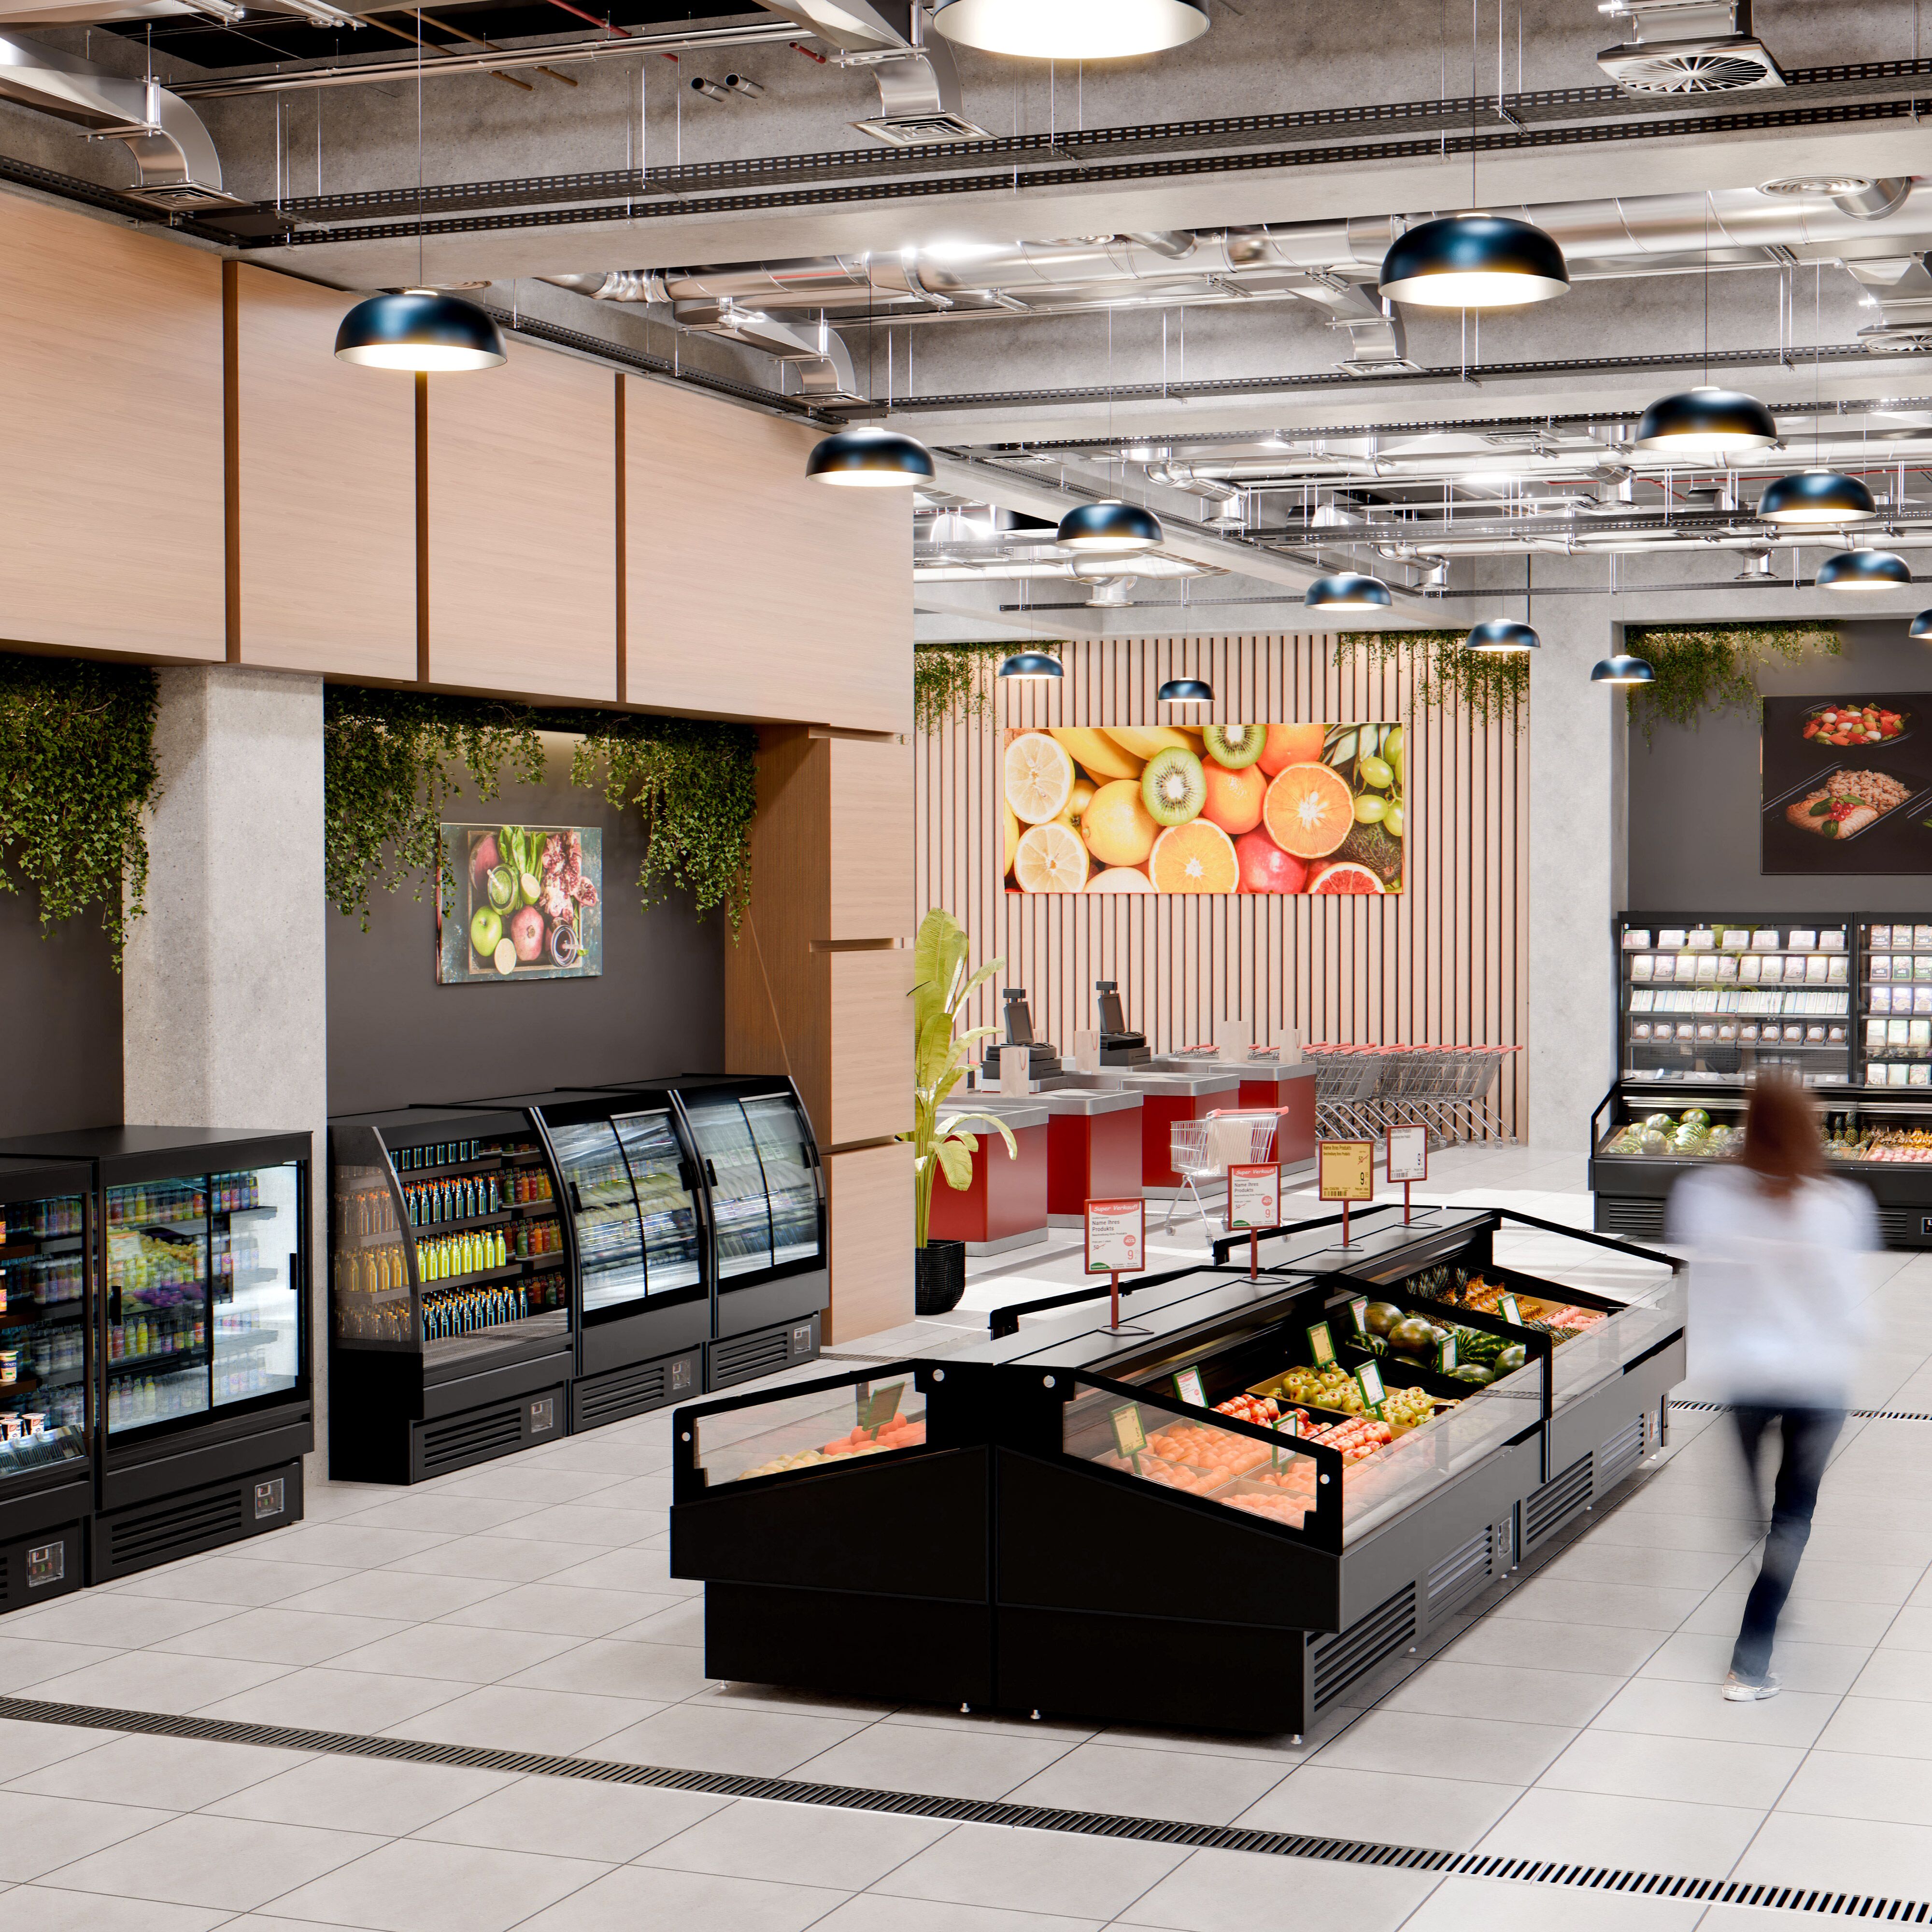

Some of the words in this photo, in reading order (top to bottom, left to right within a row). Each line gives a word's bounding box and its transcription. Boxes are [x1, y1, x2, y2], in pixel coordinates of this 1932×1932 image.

[1360, 1172, 1364, 1185] 9
[1265, 1209, 1270, 1218] 9
[1128, 1250, 1133, 1260] 9
